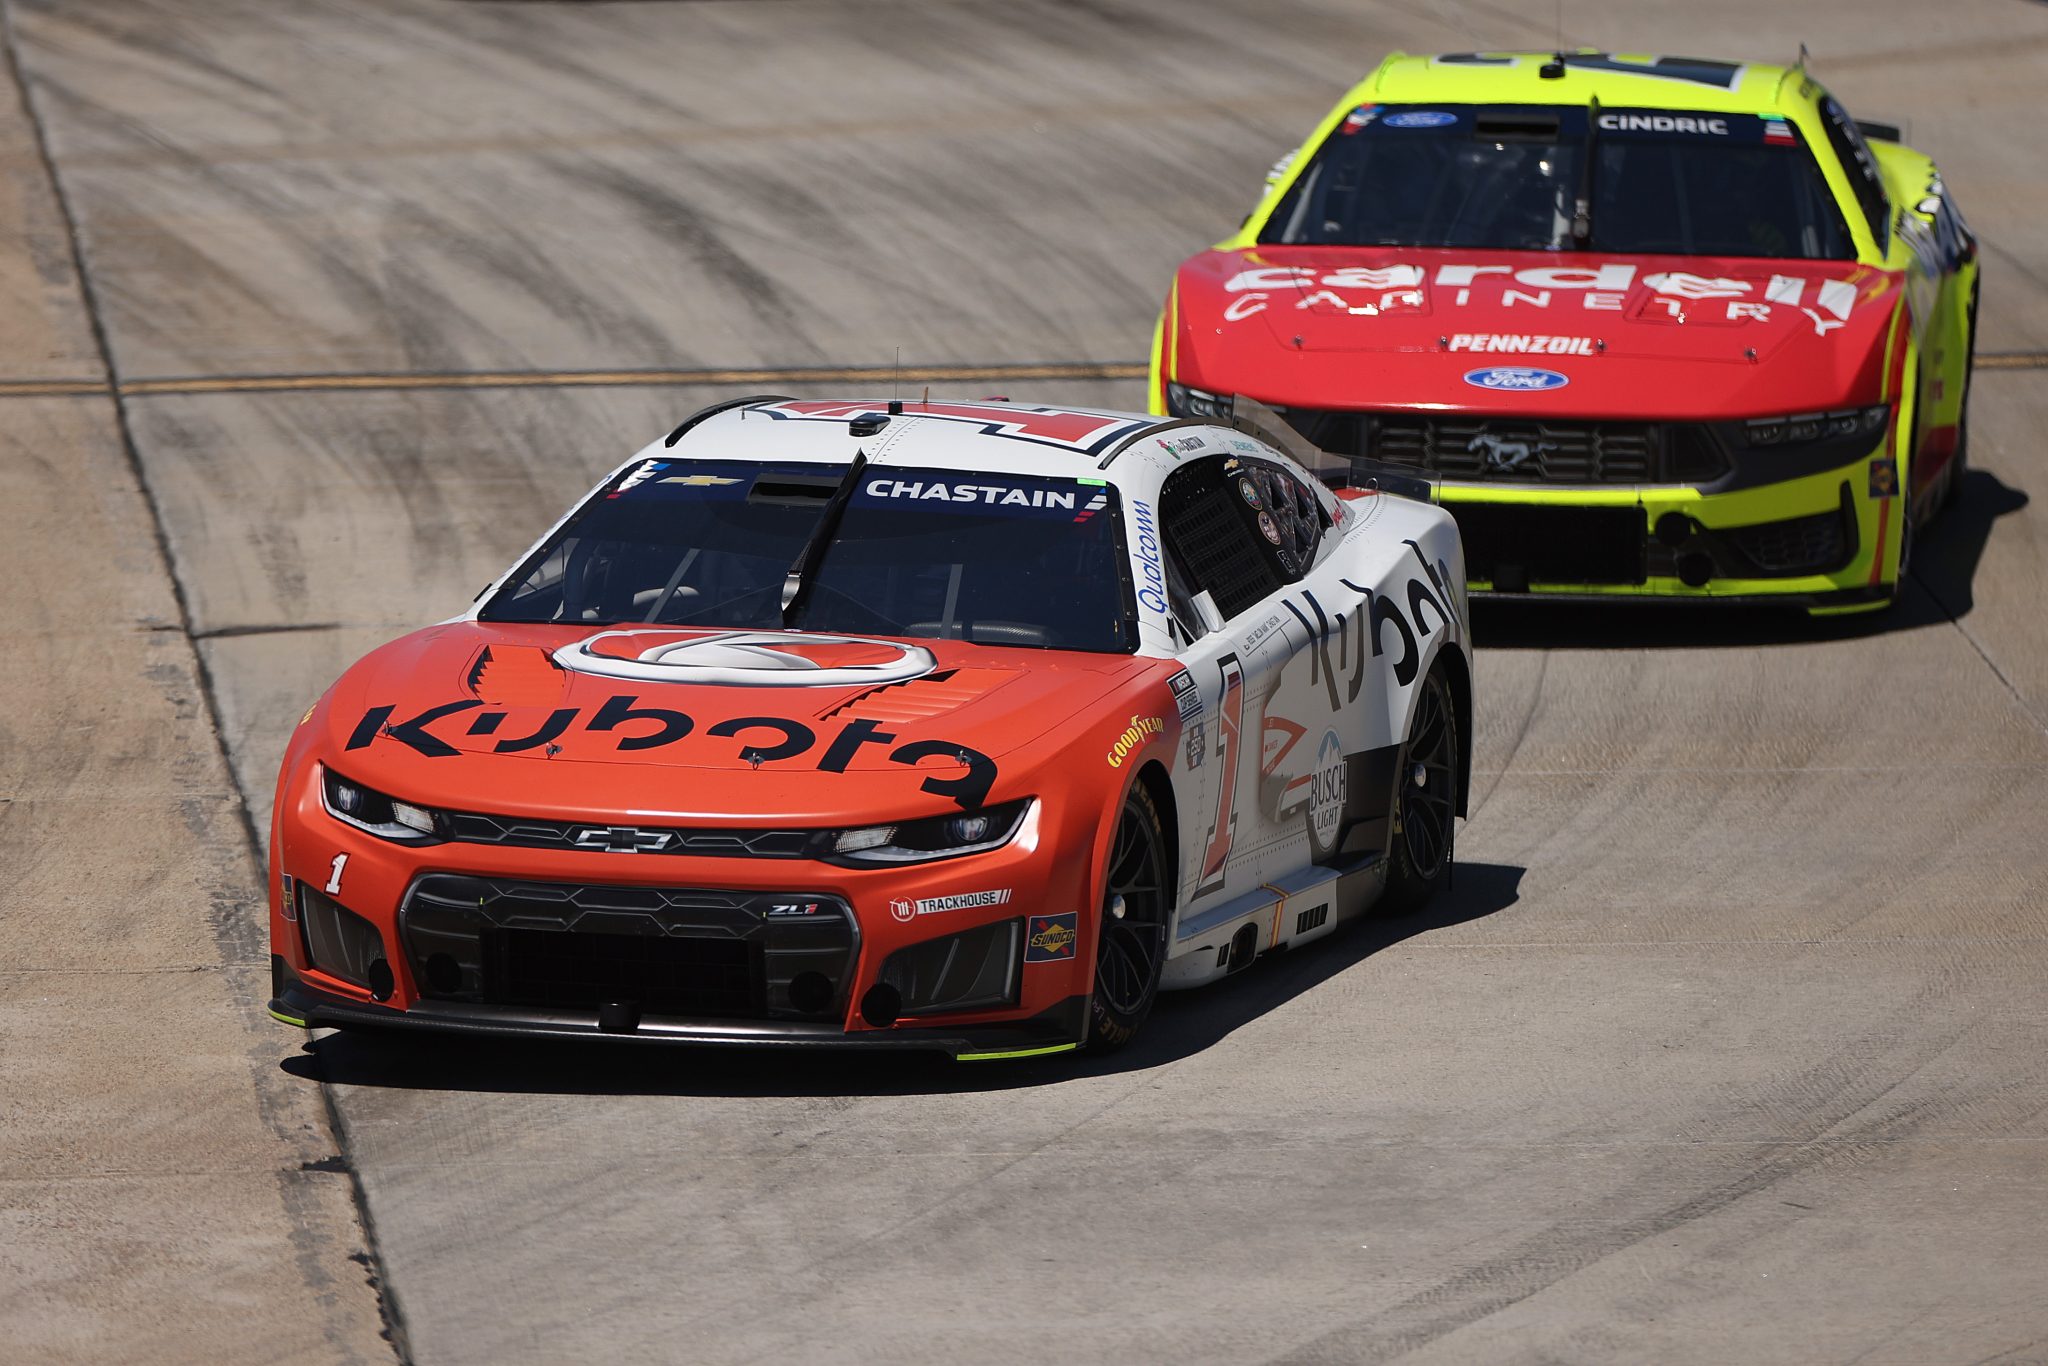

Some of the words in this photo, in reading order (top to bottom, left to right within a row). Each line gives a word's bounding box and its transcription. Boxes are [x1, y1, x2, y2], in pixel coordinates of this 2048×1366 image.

[1600, 114, 1729, 136] CINDRIC
[1224, 264, 1858, 322] cardell
[1450, 334, 1594, 356] PENNZOIL
[1478, 368, 1552, 389] Ford
[866, 479, 1075, 510] CHASTAIN
[1132, 500, 1169, 614] Qualcomm
[344, 695, 998, 810] Kubota
[1107, 715, 1164, 769] GOODYEAR
[1191, 652, 1245, 903] 1
[1311, 763, 1347, 812] BUSCH
[1317, 806, 1339, 830] LIGHT
[324, 851, 350, 895] 1
[768, 903, 818, 916] ZL1
[920, 891, 996, 913] TRACKHOUSE
[1031, 929, 1075, 947] SUNOCO
